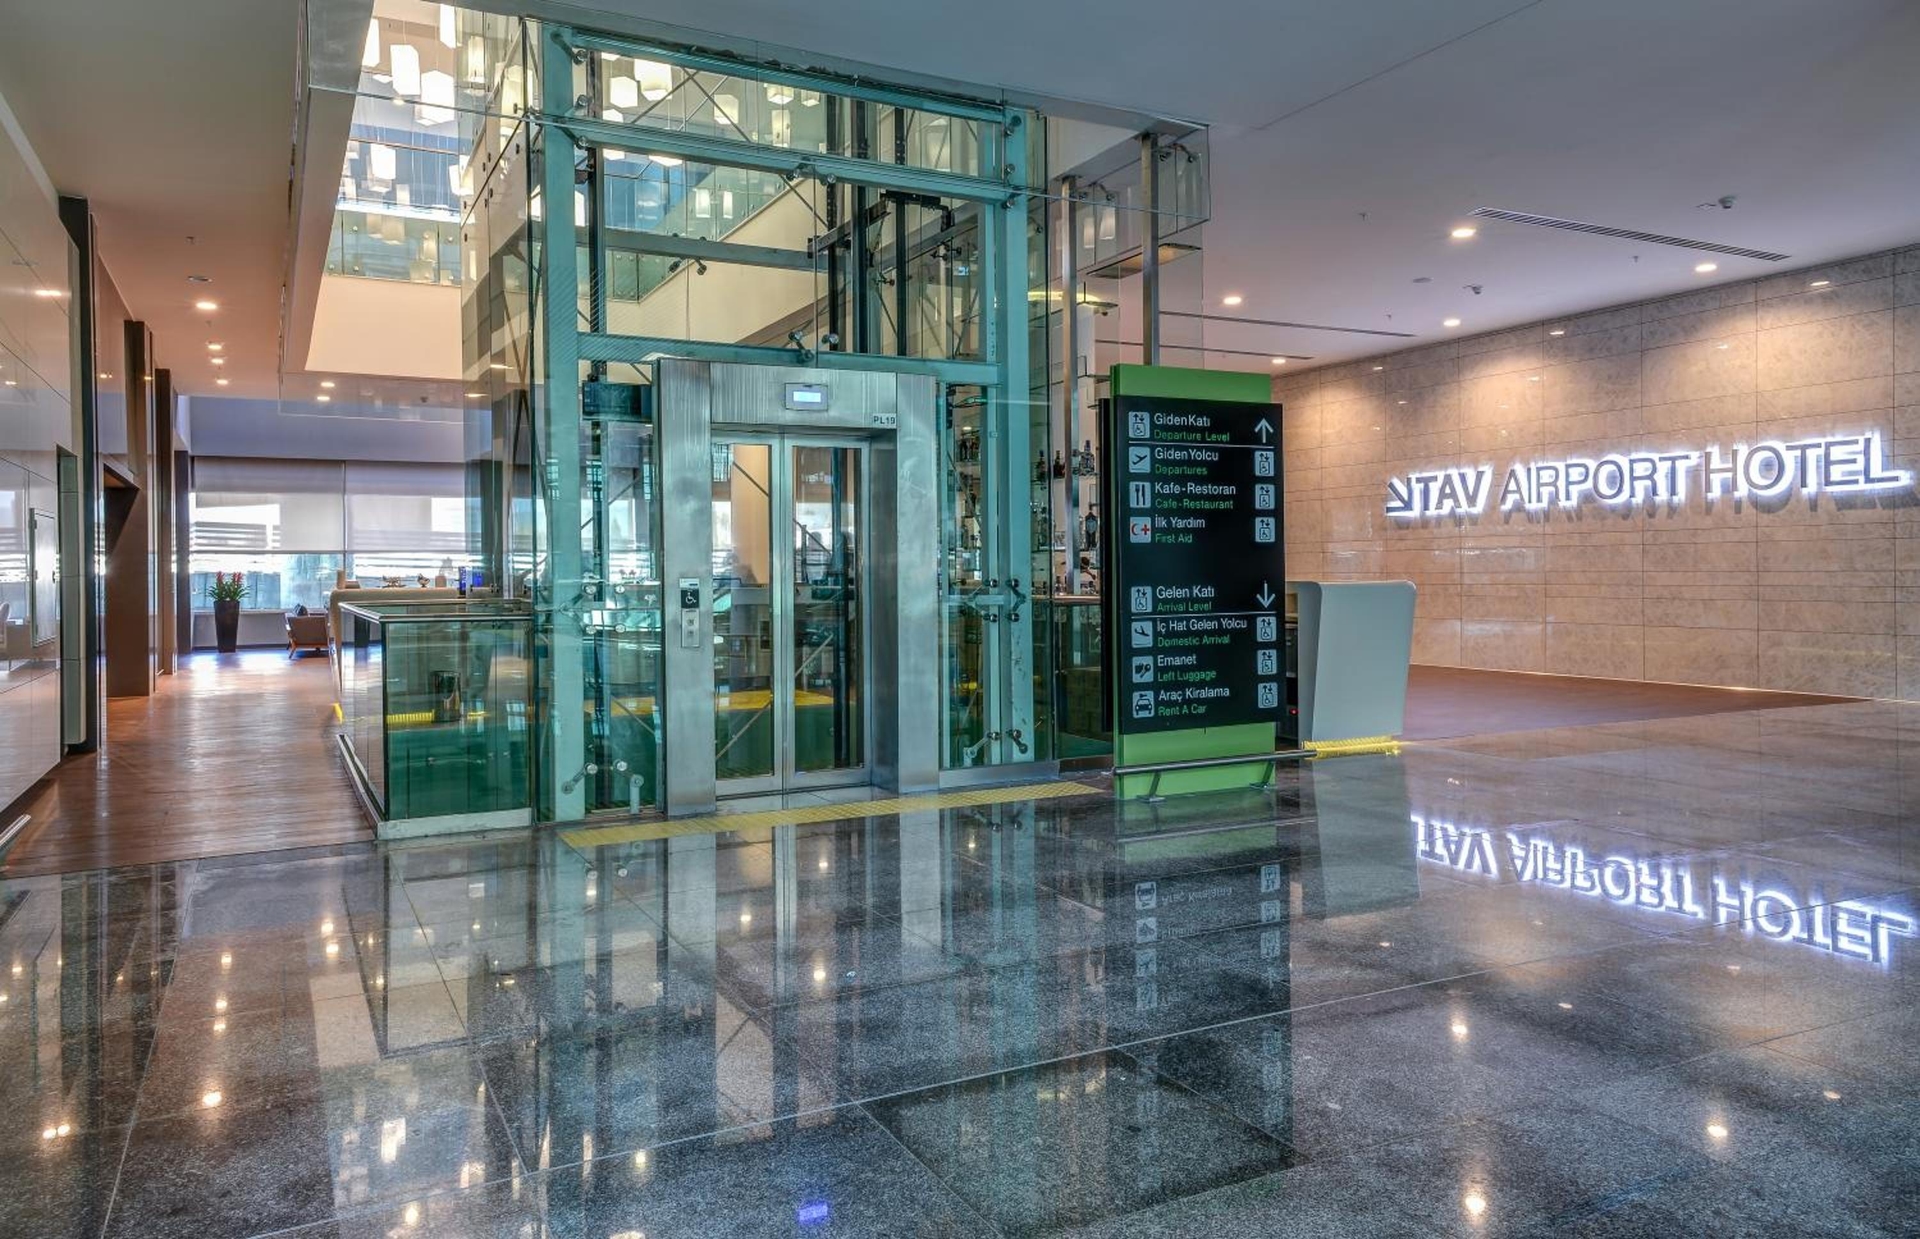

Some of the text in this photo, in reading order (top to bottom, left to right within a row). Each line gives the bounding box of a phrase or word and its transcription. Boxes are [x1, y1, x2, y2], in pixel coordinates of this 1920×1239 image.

[873, 416, 896, 425] PL19
[1154, 429, 1230, 442] Departure Level
[1154, 447, 1219, 461] Giden Yolcu
[1155, 463, 1208, 476] Departures
[1421, 434, 1901, 513] TAV AIRPORT HOTEL
[1155, 513, 1206, 528] İlk Yardım
[1155, 532, 1193, 544] First Aid
[1156, 585, 1215, 599] Gelen Katı
[1157, 601, 1212, 612] Arrival Level
[1157, 617, 1248, 634] İç Hat Gelen Yolcu
[1158, 634, 1230, 647] Domestic Arrival
[1157, 654, 1197, 666] Emanet
[1157, 669, 1217, 682] Left Luggage
[1158, 687, 1230, 702] Araç Kiralama
[1157, 704, 1208, 717] Rent A Car
